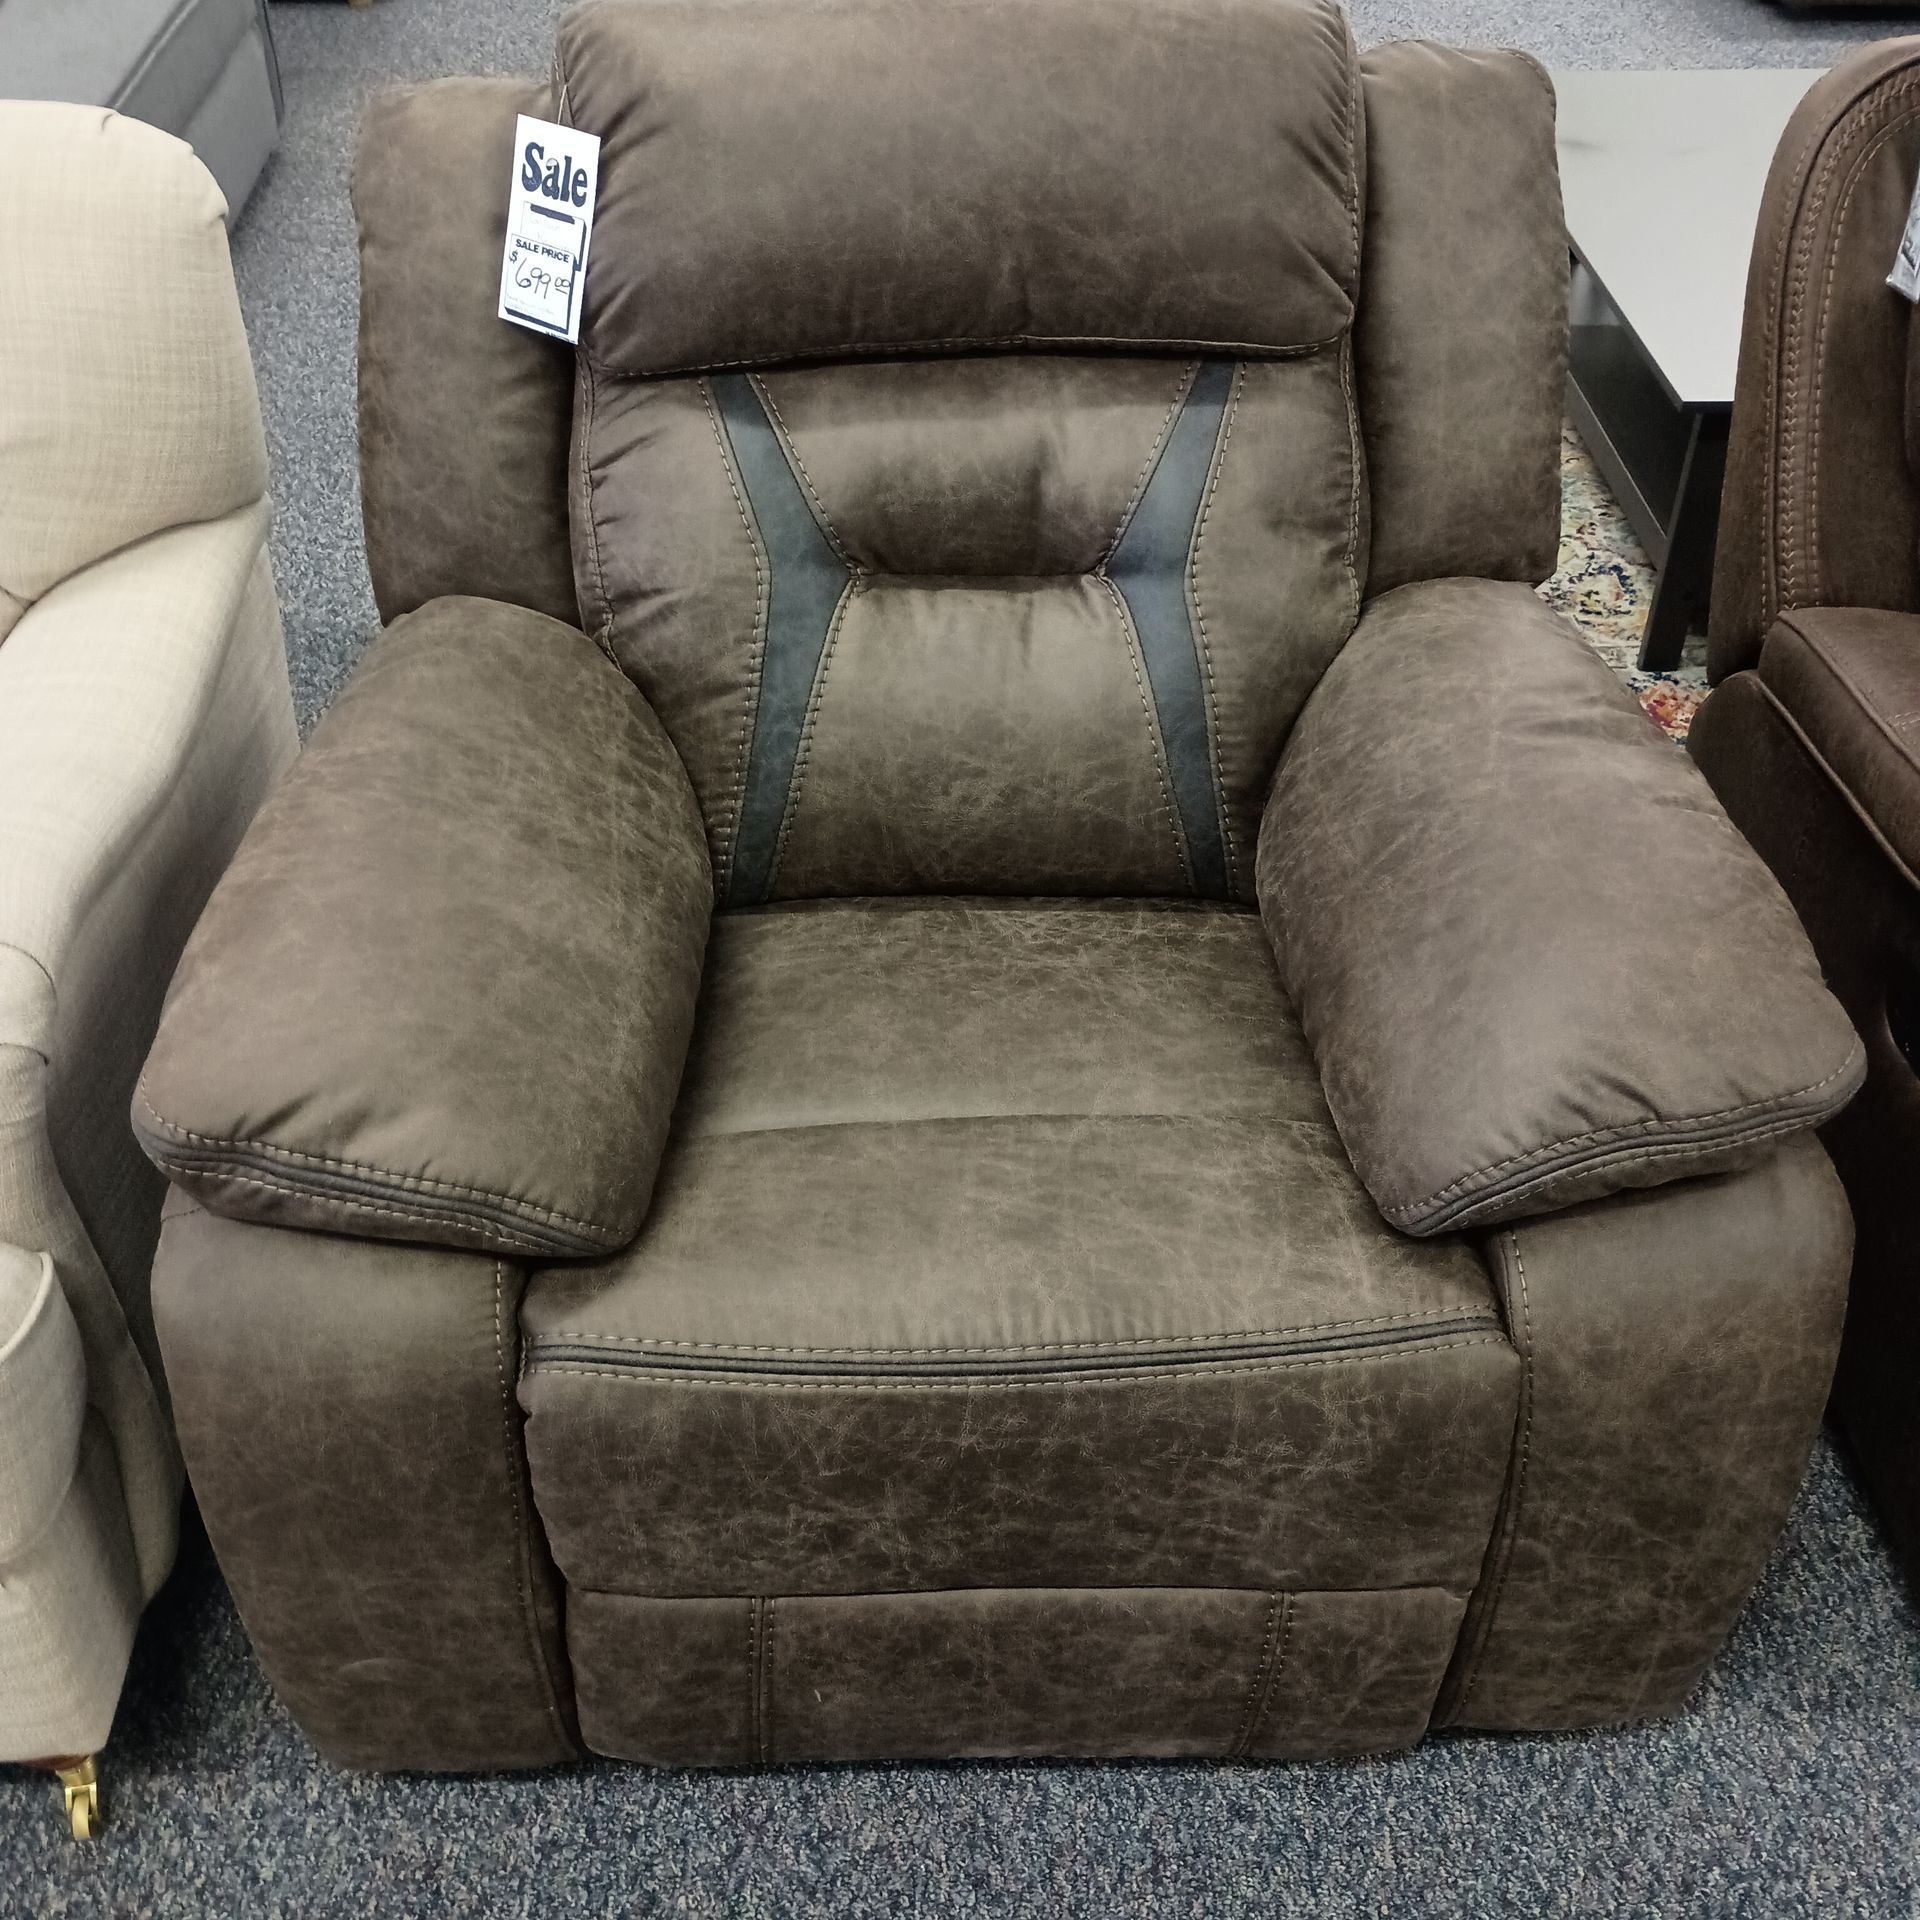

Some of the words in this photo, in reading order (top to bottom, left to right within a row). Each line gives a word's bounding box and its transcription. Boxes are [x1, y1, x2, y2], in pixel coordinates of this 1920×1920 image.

[521, 141, 588, 208] Sale
[515, 238, 539, 254] SALE
[541, 246, 570, 263] PRICE
